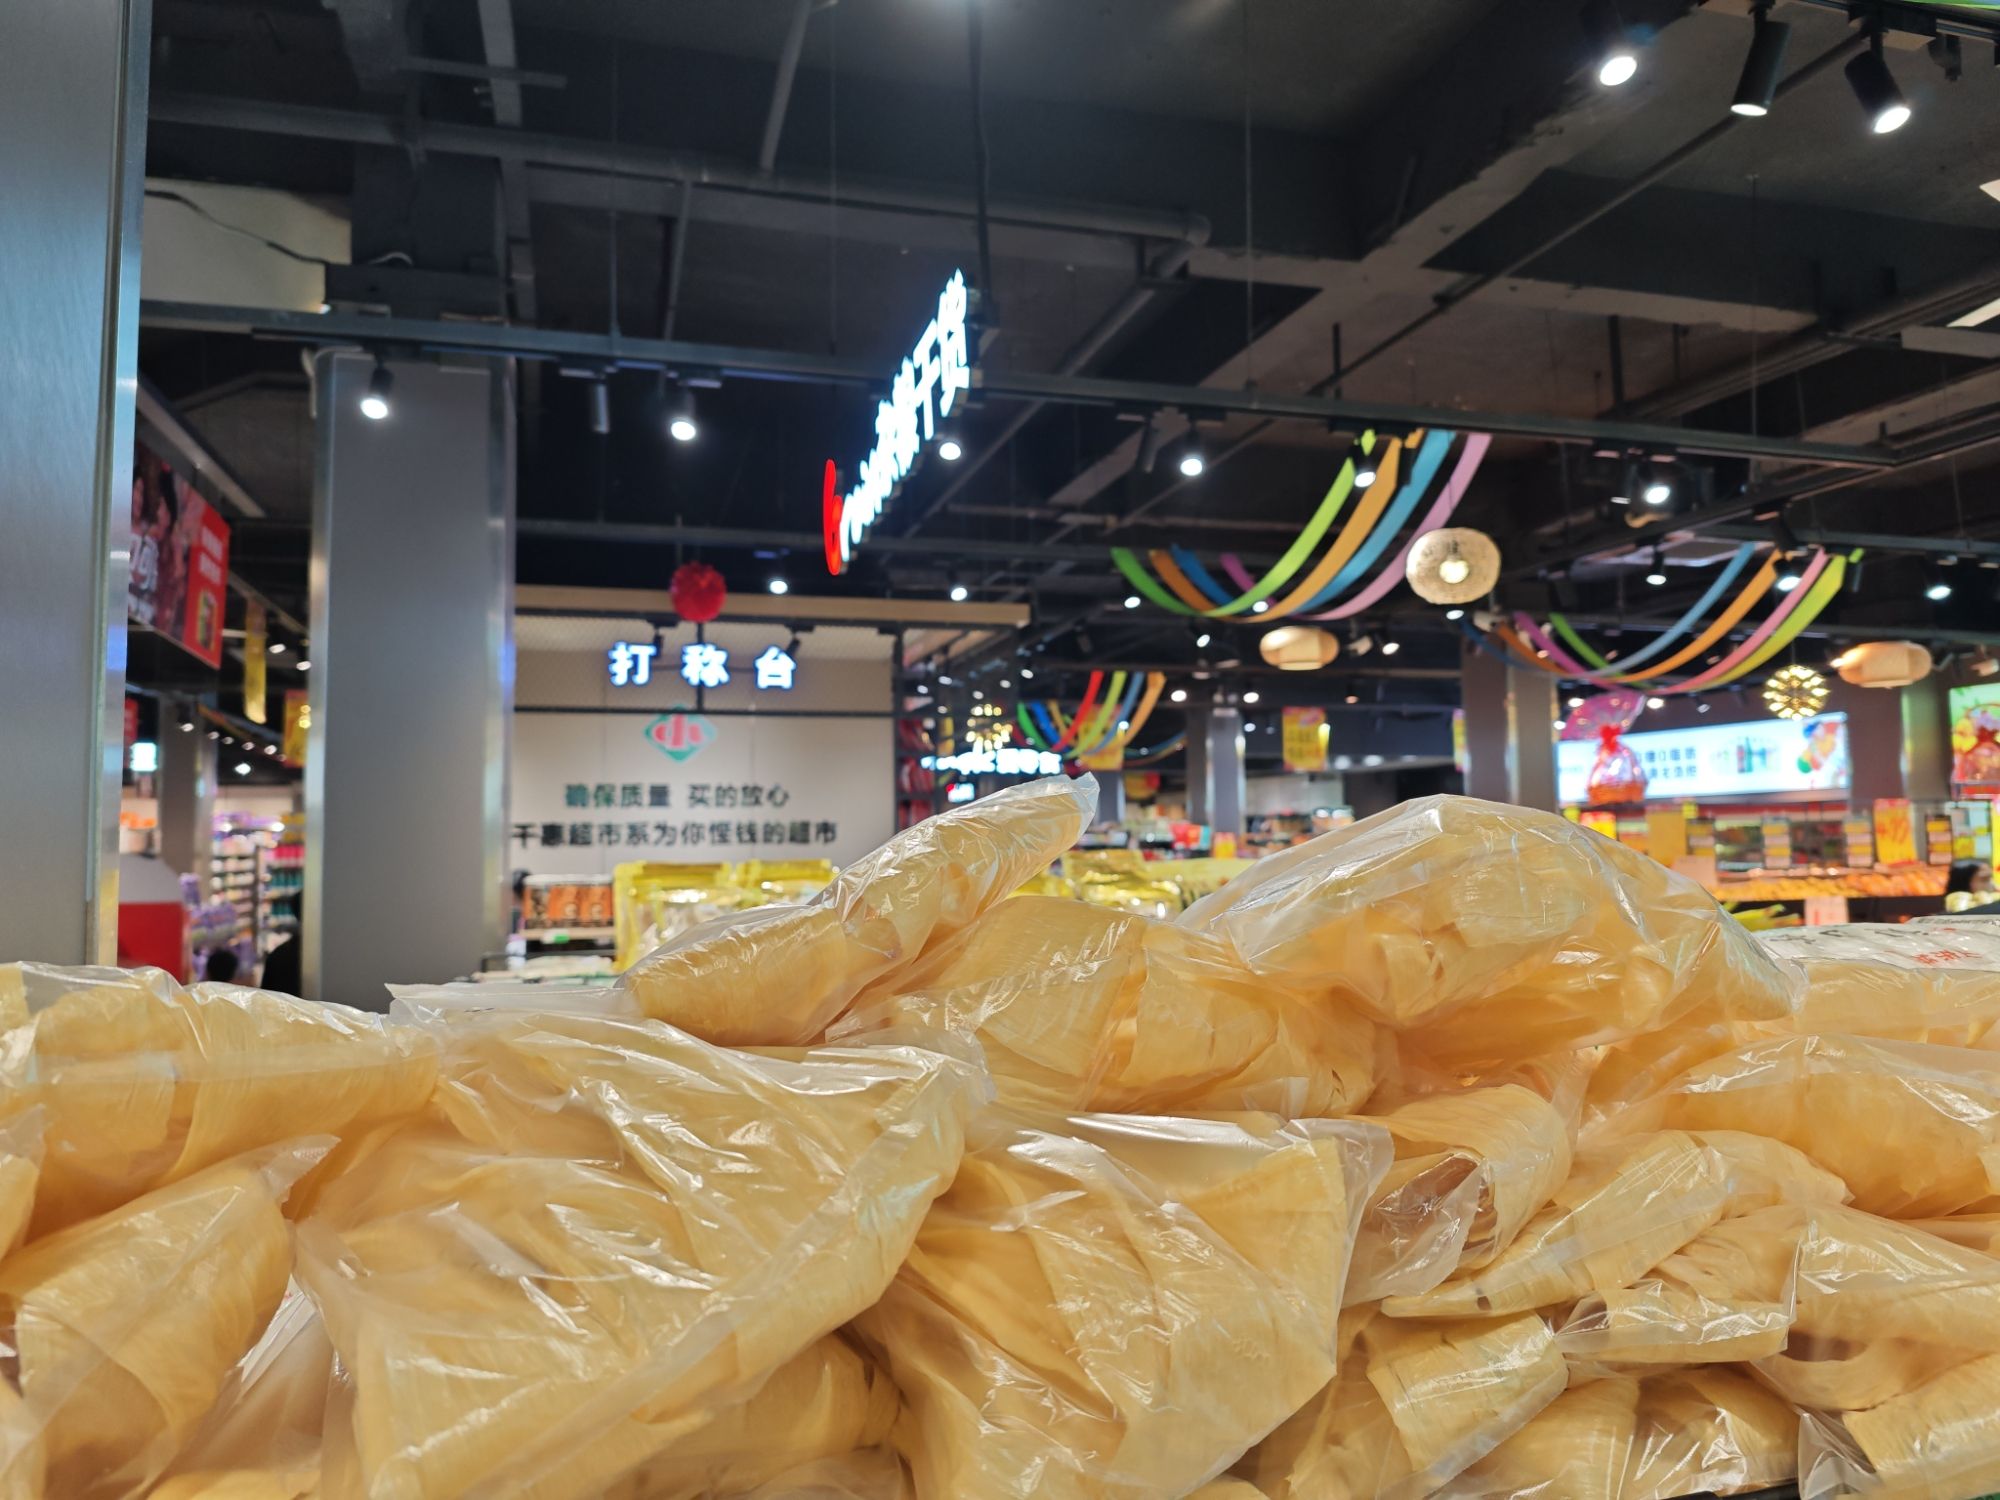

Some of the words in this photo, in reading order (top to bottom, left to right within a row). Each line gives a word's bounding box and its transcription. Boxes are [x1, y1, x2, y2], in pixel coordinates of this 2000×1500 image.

[608, 641, 797, 690] 打称台
[565, 784, 671, 808] 确保质量
[688, 784, 790, 808] 买的放心
